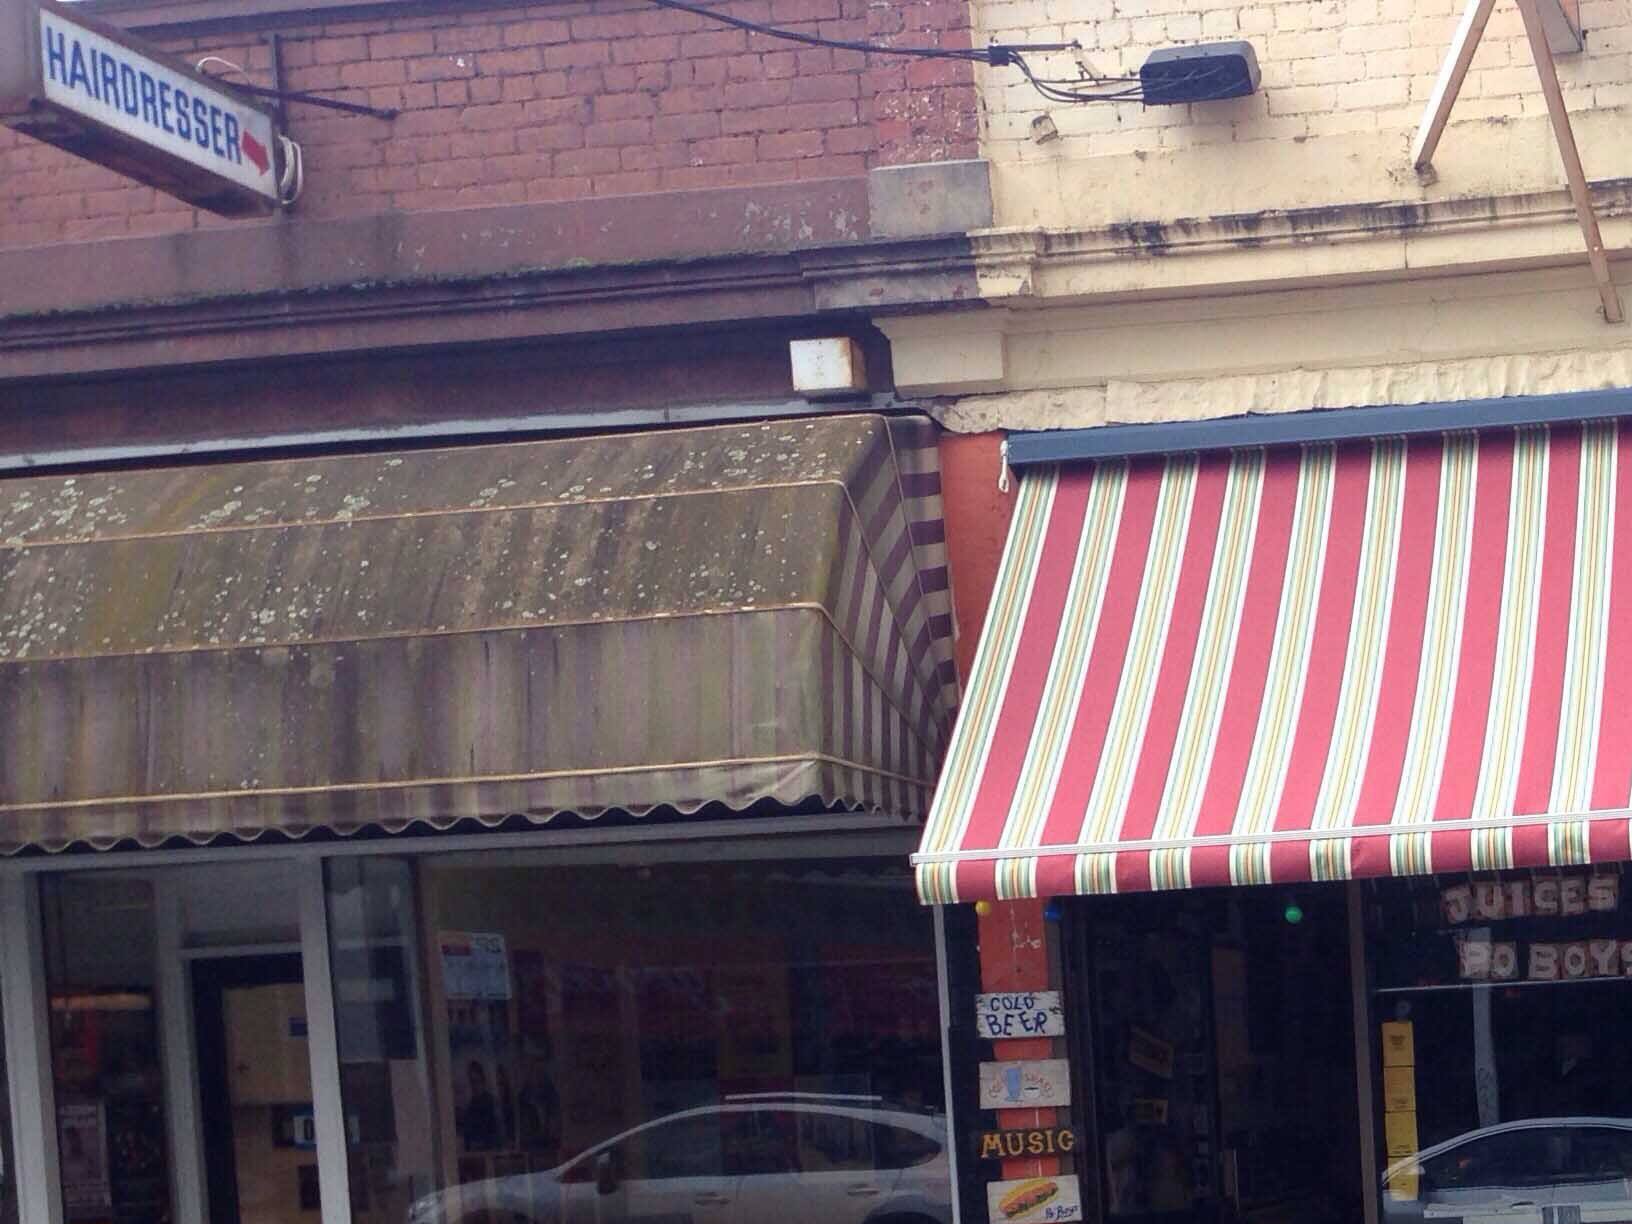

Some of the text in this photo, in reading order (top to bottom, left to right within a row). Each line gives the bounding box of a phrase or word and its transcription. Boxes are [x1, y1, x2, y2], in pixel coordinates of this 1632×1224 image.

[46, 26, 243, 165] HAIRDRESSER
[1444, 874, 1617, 924] JUICES
[1464, 940, 1516, 979] PO
[990, 997, 1035, 1012] COLD
[985, 1011, 1048, 1036] BEER
[981, 1129, 1076, 1159] MUSIC
